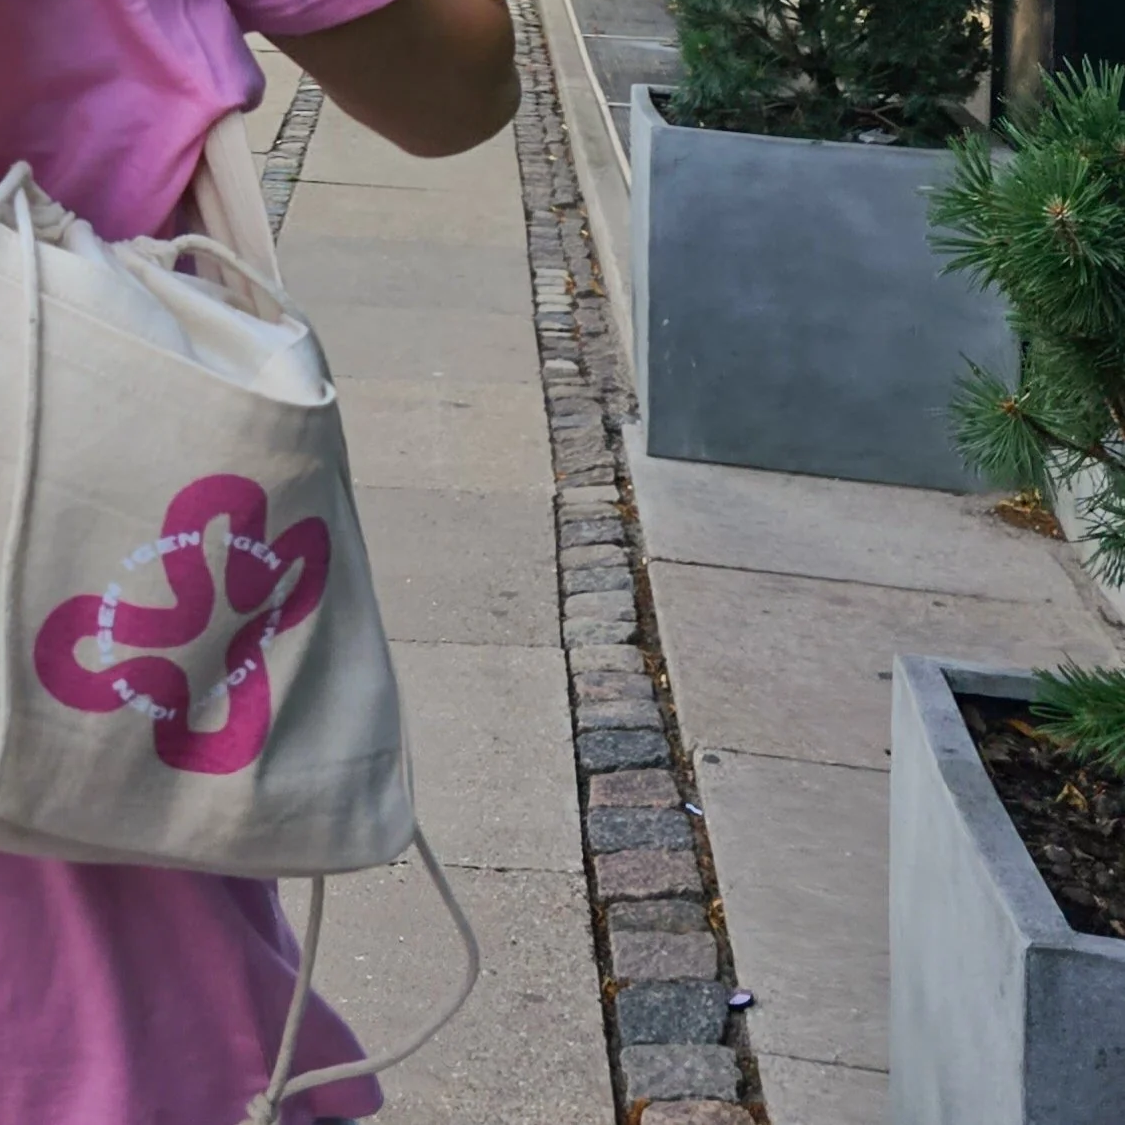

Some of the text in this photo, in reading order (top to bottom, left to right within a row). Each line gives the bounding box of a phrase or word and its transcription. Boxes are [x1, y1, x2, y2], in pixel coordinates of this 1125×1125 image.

[122, 531, 200, 571] IGEN
[224, 532, 282, 570] IGEN
[112, 678, 176, 720] IGEN
